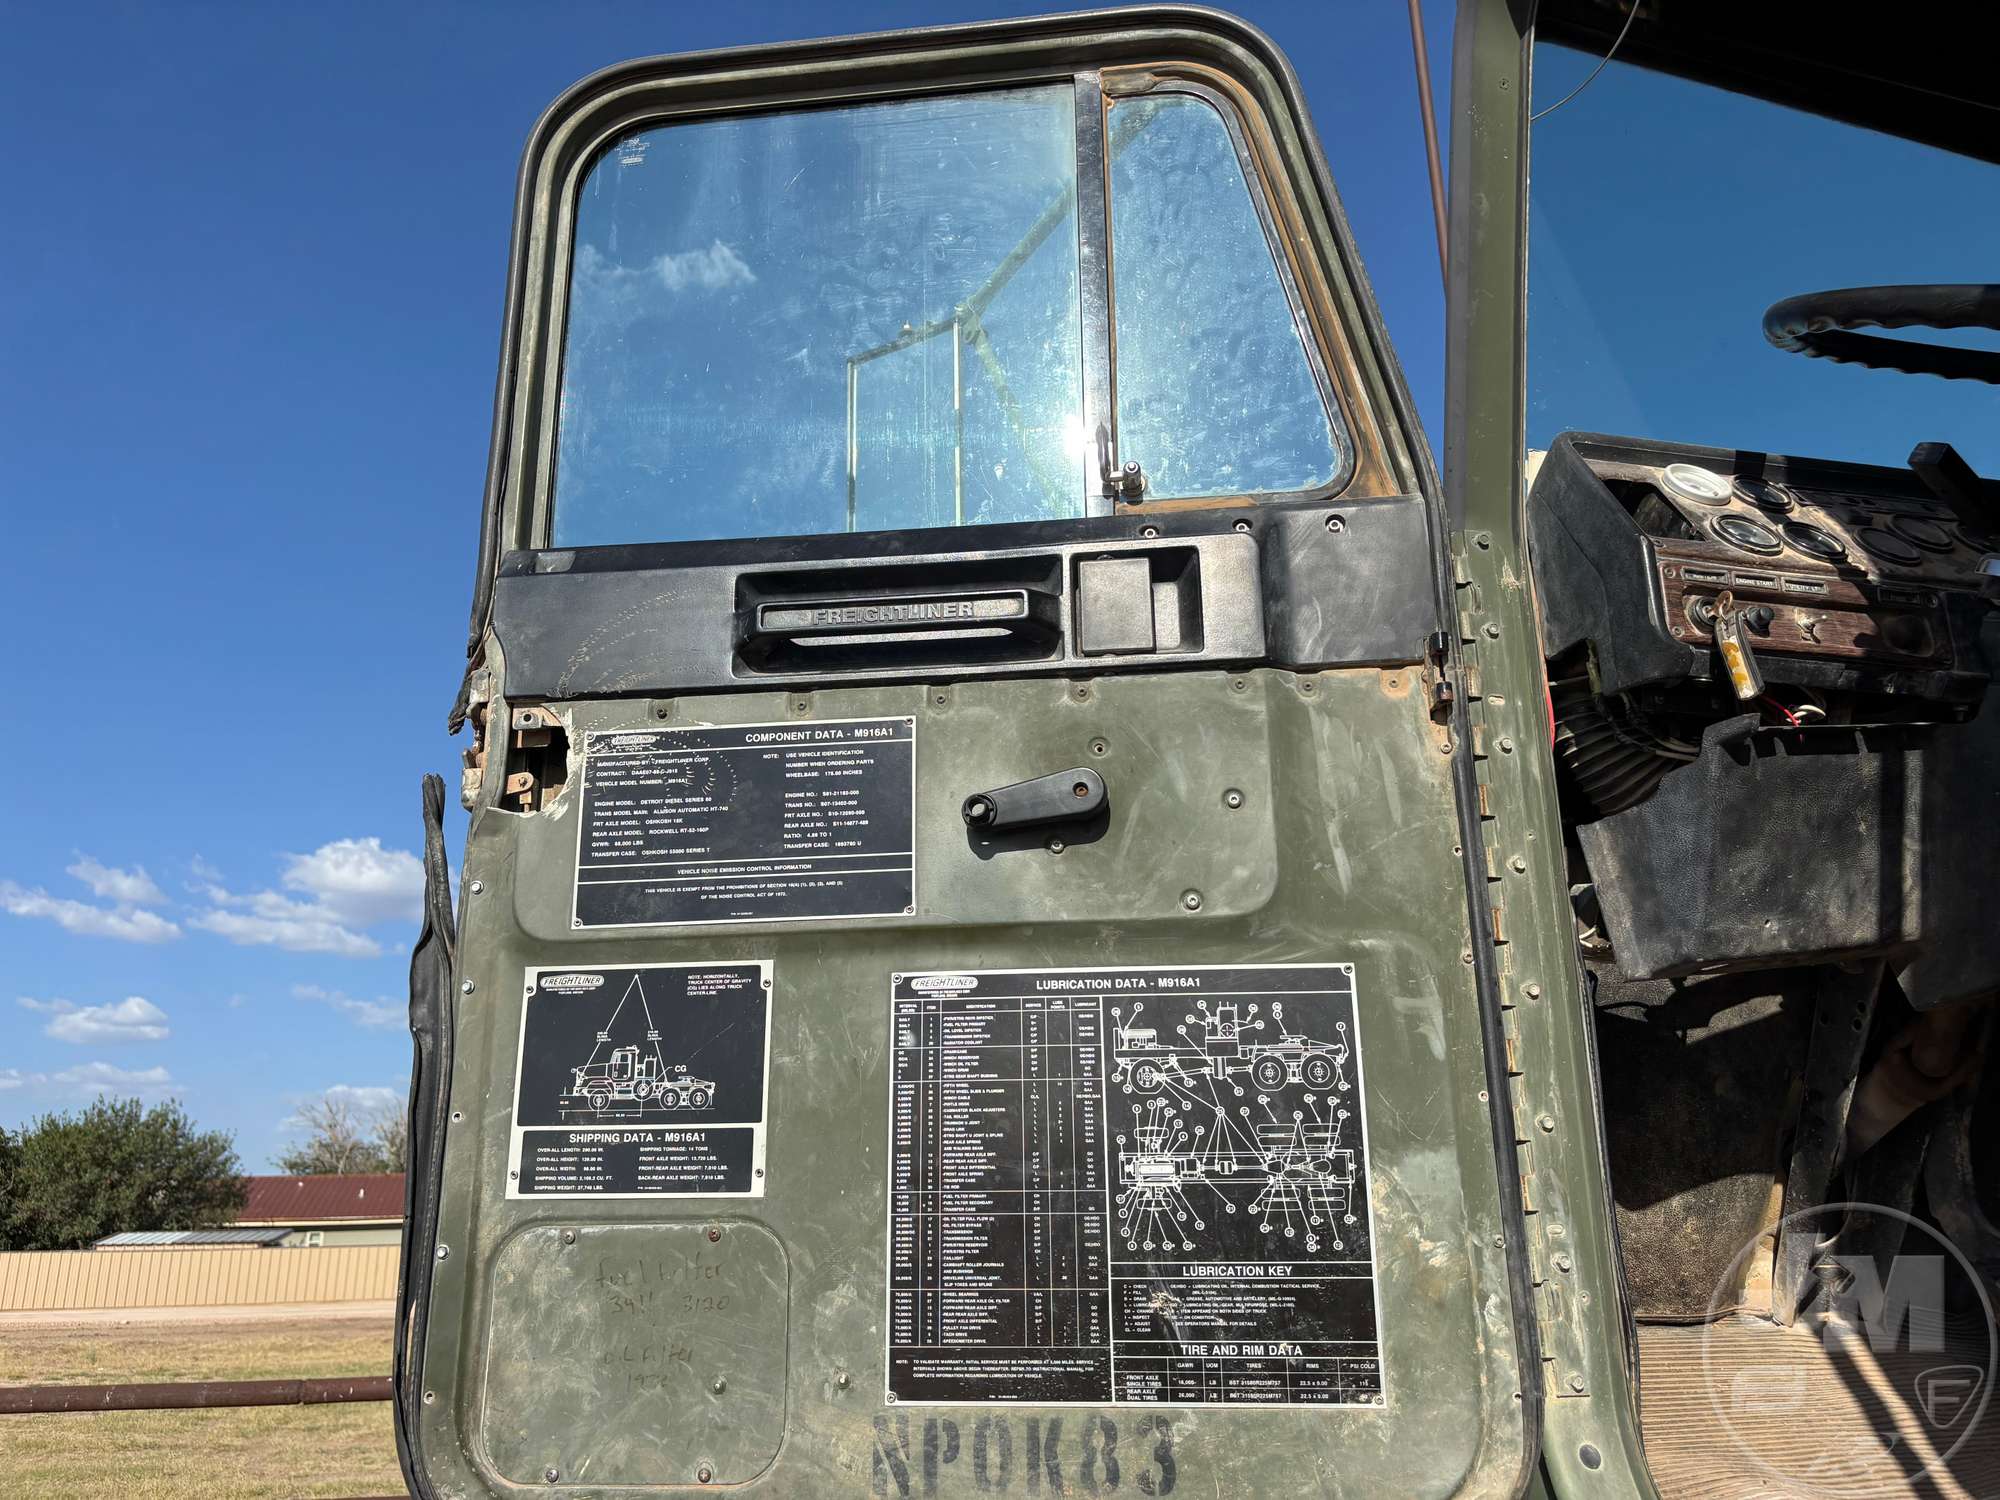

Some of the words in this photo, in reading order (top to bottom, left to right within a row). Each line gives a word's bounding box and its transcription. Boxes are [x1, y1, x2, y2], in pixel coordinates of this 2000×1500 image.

[812, 601, 975, 626] FREIGHTLINER
[745, 731, 811, 742] COMPONENT
[815, 729, 844, 739] DATA
[855, 727, 894, 737] M916A1
[543, 977, 602, 986] FREIGHTLINER
[914, 978, 974, 986] FREIGHTLINER
[1036, 979, 1112, 989] LUBRICATION
[1115, 978, 1147, 988] DATA
[1158, 977, 1200, 987] M916A1
[569, 1133, 620, 1143] SHIPPING
[623, 1132, 654, 1142] DATA
[665, 1132, 706, 1142] M916A1
[1182, 1266, 1264, 1276] LUBRICATION
[1268, 1265, 1293, 1276] KEY
[1181, 1344, 1208, 1355] TIRE
[1212, 1344, 1238, 1355] AND
[1242, 1345, 1265, 1355] RIM
[1269, 1345, 1303, 1356] DATA
